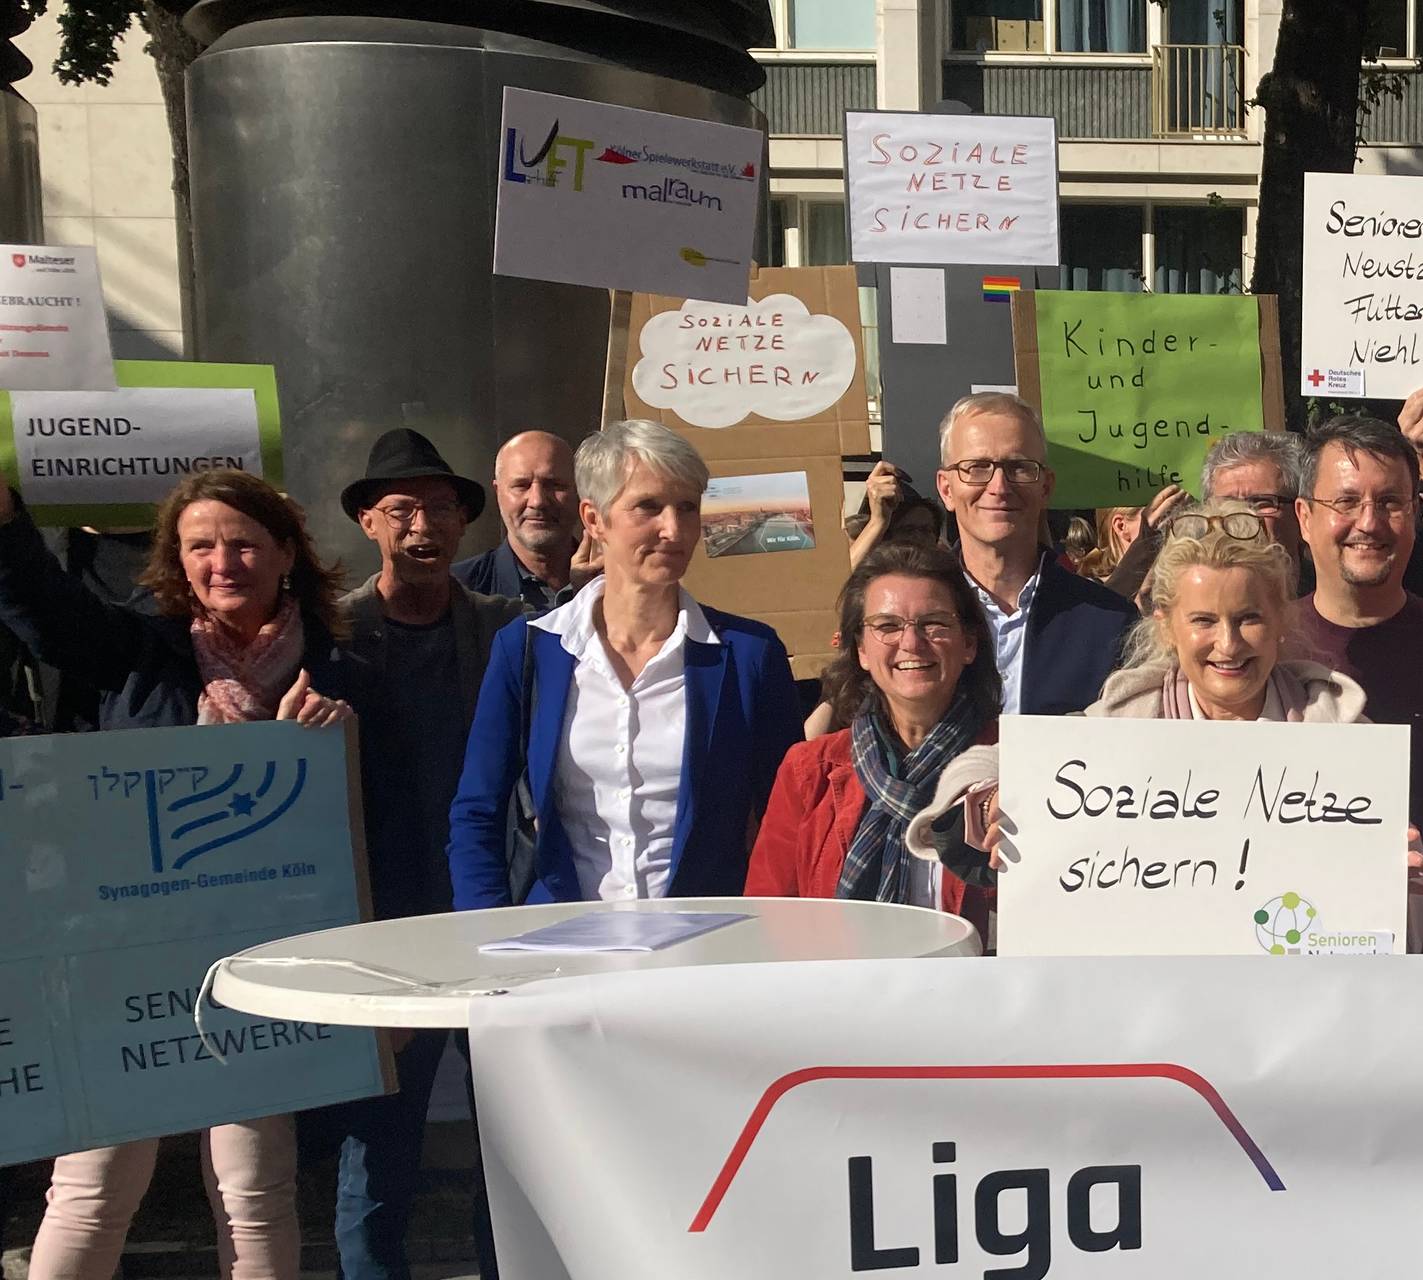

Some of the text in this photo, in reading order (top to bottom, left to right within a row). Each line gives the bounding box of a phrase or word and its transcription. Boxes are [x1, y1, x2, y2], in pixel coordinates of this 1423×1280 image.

[622, 177, 722, 211] malraum
[906, 172, 1013, 193] NETZE
[0, 295, 73, 307] EBRAUCHT
[695, 335, 785, 353] NETZE
[1349, 333, 1421, 367] Niehl
[1088, 367, 1144, 390] und
[27, 417, 142, 437] JUGEND-
[1117, 464, 1184, 491] hilfe
[1047, 760, 1383, 824] Soziale Netze
[98, 863, 316, 902] Synagogen-Gemeinde Köln
[1059, 845, 1217, 892] sichern
[1308, 932, 1377, 947] Senioren
[121, 1020, 332, 1073] NETZWERKE
[848, 1141, 1142, 1280] Liga
